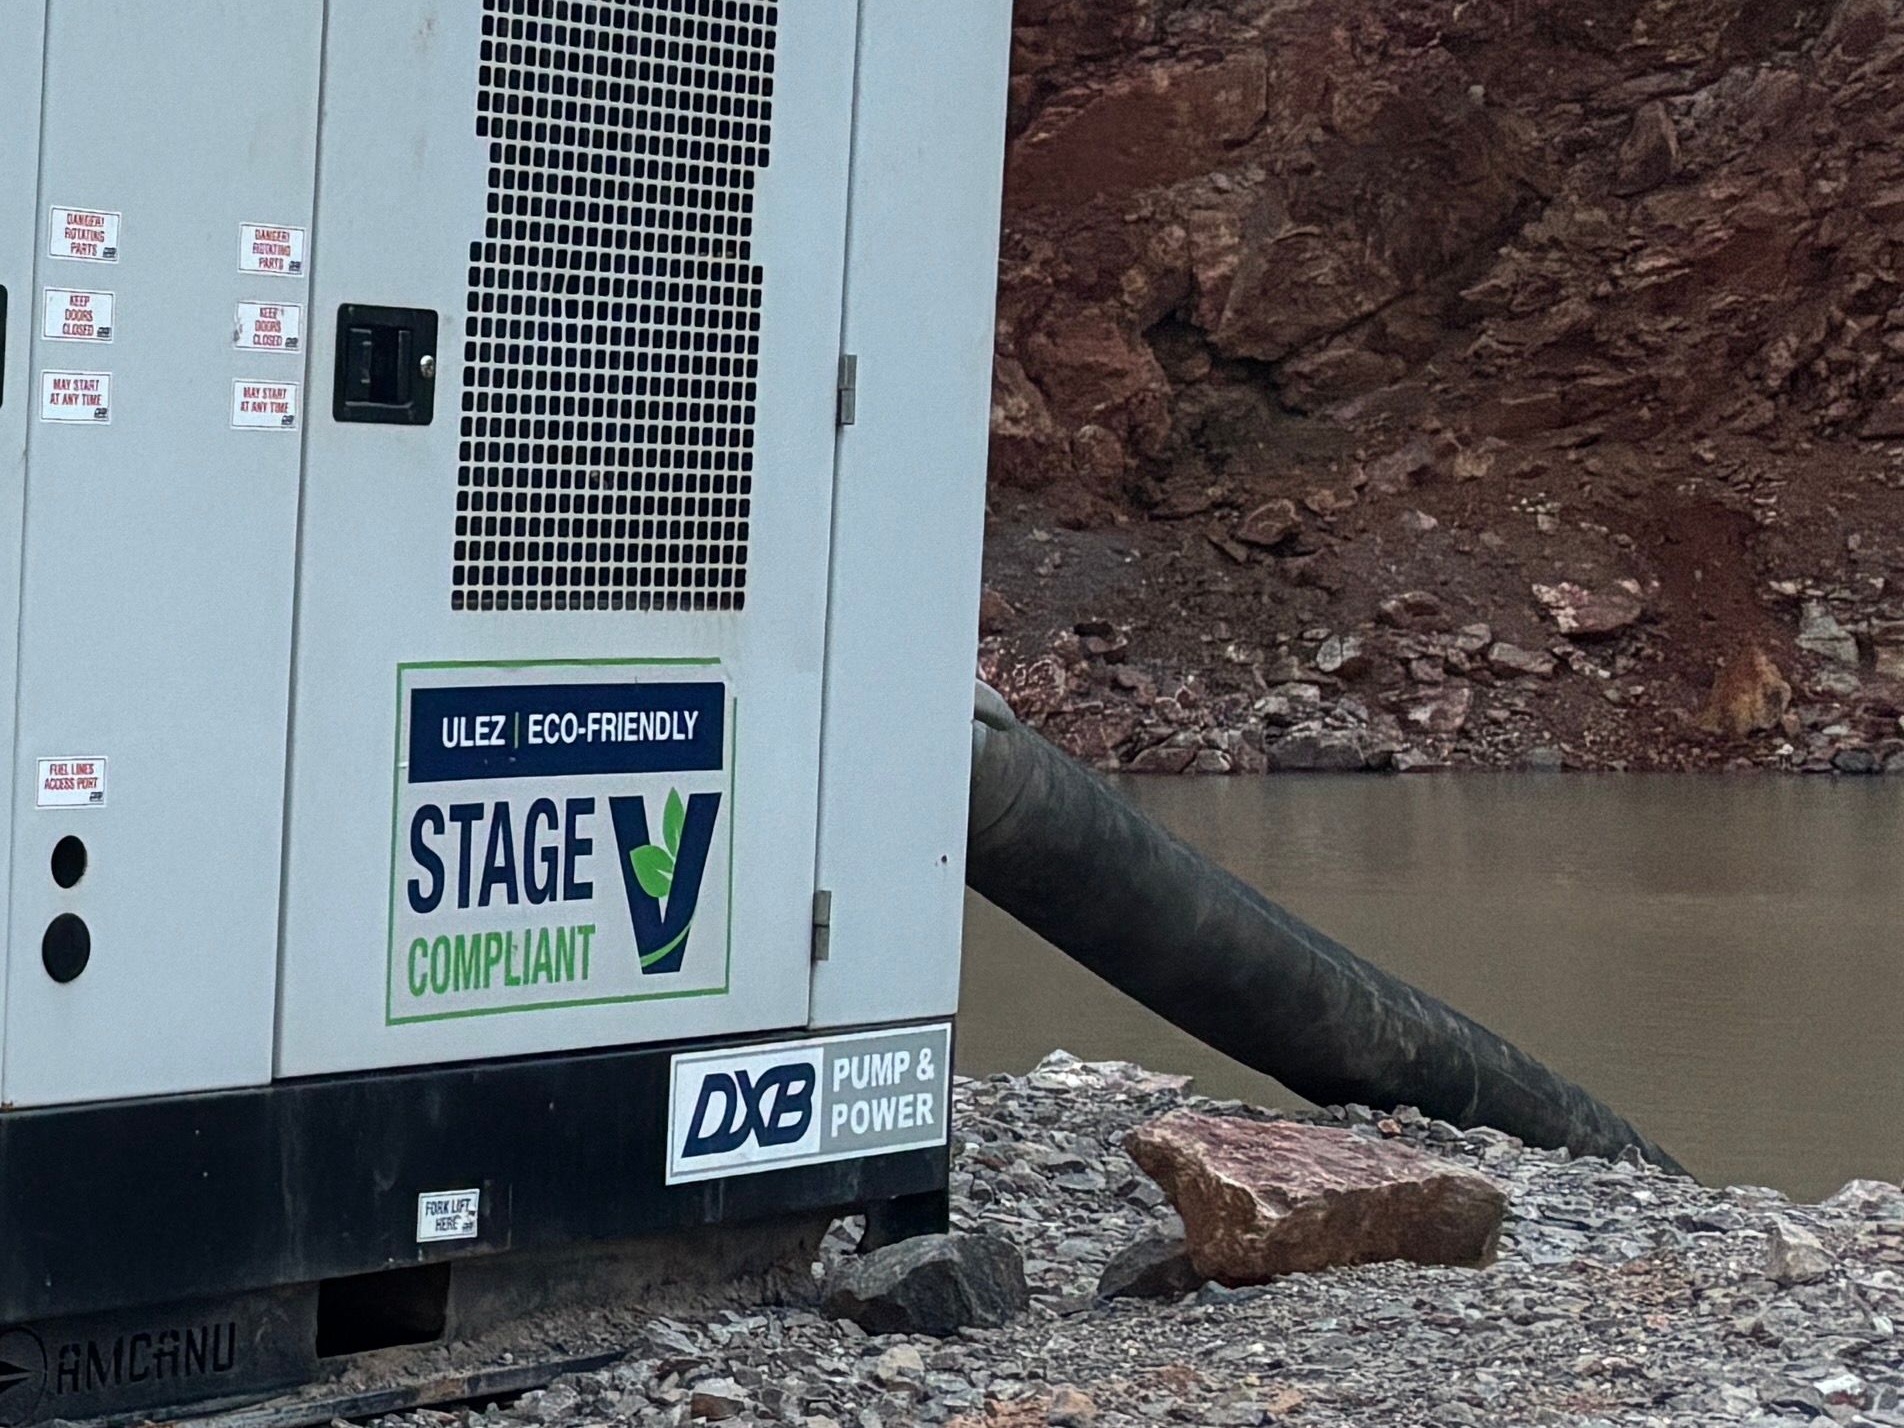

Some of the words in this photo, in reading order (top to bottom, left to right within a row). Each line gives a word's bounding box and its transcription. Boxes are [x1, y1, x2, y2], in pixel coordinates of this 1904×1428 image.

[71, 242, 98, 256] PARTS
[70, 295, 90, 307] KEEP
[65, 308, 93, 322] DOORS
[63, 323, 94, 336] CLOSED
[253, 334, 282, 346] CLOSED
[53, 379, 71, 390] MAY
[73, 379, 100, 391] START
[50, 393, 59, 405] AT
[62, 393, 79, 406] ANY
[82, 393, 102, 406] TIME
[243, 387, 261, 398] MAY
[262, 388, 287, 399] START
[251, 401, 268, 413] ANY
[270, 402, 289, 413] TIME
[442, 714, 505, 747] ULEZ
[528, 710, 699, 744] ECO-FRIENDLY
[50, 763, 69, 775] FUEL
[71, 763, 94, 775] LINES
[44, 778, 75, 790] ACCESS
[77, 777, 98, 790] PORT
[407, 797, 596, 914] STAGE
[608, 792, 722, 975] V
[407, 924, 596, 997] COMPLIANT
[681, 1062, 816, 1159] DXB
[832, 1051, 911, 1092] PUMP
[916, 1047, 935, 1081] &
[831, 1093, 934, 1138] POWER
[426, 1200, 449, 1216] FORK
[452, 1199, 471, 1213] LIFT
